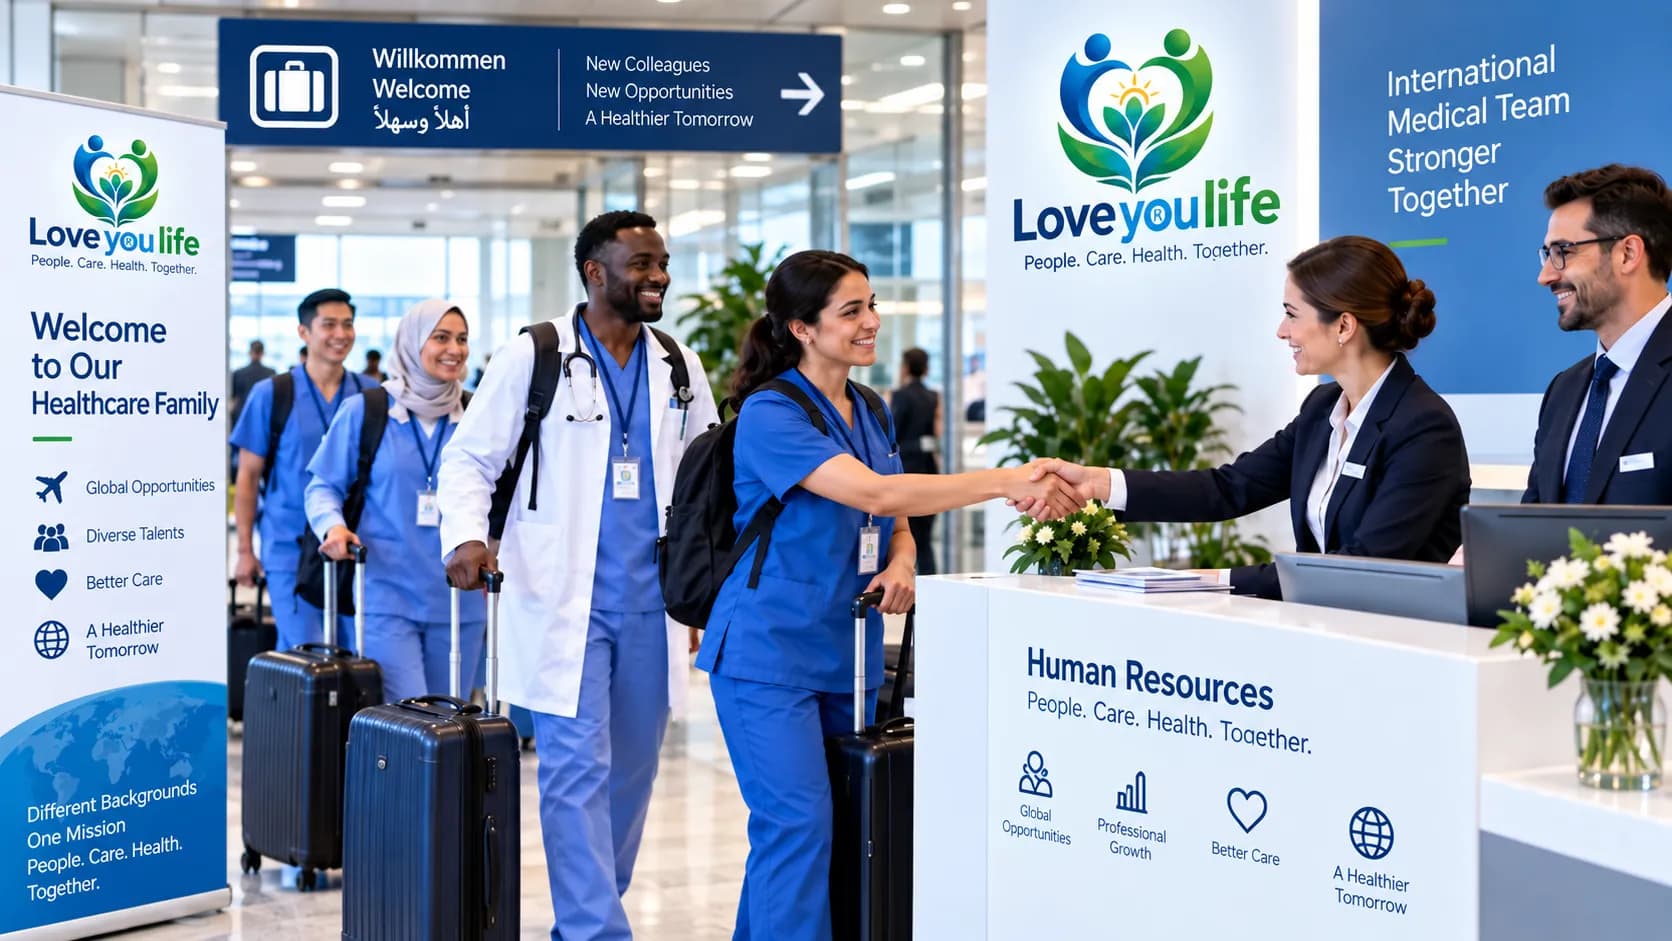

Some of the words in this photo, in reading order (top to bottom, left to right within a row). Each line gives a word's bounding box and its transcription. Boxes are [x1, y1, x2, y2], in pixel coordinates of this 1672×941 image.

[373, 48, 505, 69] Willkommen
[587, 56, 620, 71] New
[625, 56, 710, 75] Colleagues
[1388, 44, 1555, 97] International
[373, 78, 470, 99] Welcome
[587, 83, 620, 98] New
[625, 83, 733, 102] Opportunities
[586, 111, 596, 125] A
[602, 110, 669, 125] Healthier
[674, 111, 753, 126] Tomorrow
[1388, 96, 1487, 136] Medical
[1495, 93, 1569, 120] Team
[1388, 143, 1501, 174] Stronger
[1388, 179, 1508, 217] Together
[32, 255, 73, 269] People.
[78, 257, 106, 270] Care.
[110, 259, 148, 272] Health.
[151, 262, 196, 275] Together.
[1025, 254, 1080, 272] People.
[1087, 251, 1126, 266] Care.
[1133, 245, 1187, 263] Health.
[31, 312, 166, 343] Welcome
[32, 353, 61, 379] to
[70, 352, 122, 379] Our
[33, 391, 149, 415] Healthcare
[156, 391, 219, 421] Family
[86, 480, 128, 495] Global
[132, 478, 215, 496] Opportunities
[87, 529, 136, 543] Diverse
[140, 526, 184, 540] Talents
[87, 576, 128, 589] Better
[132, 573, 162, 586] Care
[87, 624, 97, 638] A
[102, 619, 164, 637] Healthier
[87, 643, 159, 659] Tomorrow
[1028, 647, 1116, 688] Human
[1126, 660, 1274, 710] Resources
[1028, 691, 1087, 720] People.
[1094, 701, 1139, 726] Care.
[1148, 710, 1212, 738] Health.
[28, 799, 96, 823] Different
[102, 779, 197, 810] Backgrounds
[1021, 804, 1051, 821] Global
[28, 832, 61, 848] One
[66, 817, 125, 842] Mission
[1003, 819, 1071, 845] Opportunities
[1098, 818, 1166, 843] Professional
[28, 853, 85, 876] People.
[89, 848, 127, 864] Care.
[133, 835, 182, 857] Health.
[1110, 841, 1151, 860] Growth
[1212, 841, 1248, 860] Better
[1252, 849, 1280, 865] Care
[27, 877, 100, 901] Together.
[1333, 866, 1343, 880] A
[1348, 868, 1409, 893] Healthier
[1335, 888, 1407, 915] Tomorrow
